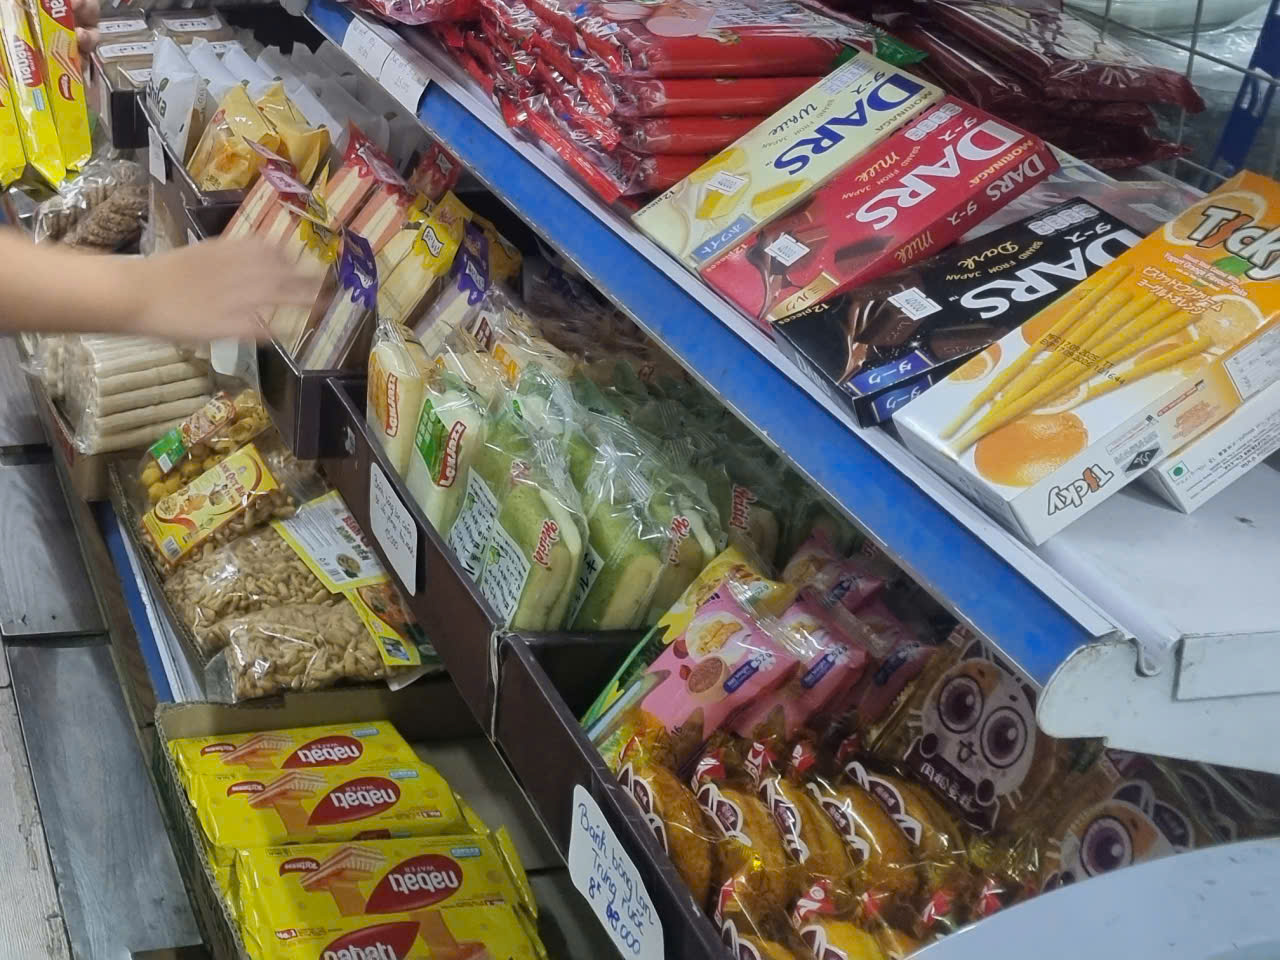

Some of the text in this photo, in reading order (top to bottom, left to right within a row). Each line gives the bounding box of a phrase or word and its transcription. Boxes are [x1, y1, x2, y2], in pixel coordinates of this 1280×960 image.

[851, 71, 887, 94] ダース
[768, 104, 818, 137] White
[774, 73, 926, 176] DARS
[875, 90, 933, 133] MORINAGA
[937, 116, 978, 141] ダース
[854, 119, 1025, 231] DARS
[855, 151, 901, 183] Milk
[876, 168, 900, 185] FROM
[970, 140, 1034, 186] MORINAGA
[985, 152, 1047, 202] DARS
[841, 184, 872, 200] JAPAN
[947, 200, 978, 227] ダース
[699, 220, 744, 256] ホワイト
[1064, 221, 1112, 243] ダース
[706, 242, 749, 273] 12pieces
[894, 230, 934, 265] Milk
[945, 240, 1044, 282] BRAND FROM JAPAN
[957, 240, 1020, 269] Dark
[960, 228, 1144, 320] DARS
[784, 286, 822, 311] ミルク
[778, 302, 831, 325] 12pieces
[869, 359, 912, 383] ダーク
[1047, 463, 1115, 516] Ticky
[297, 744, 361, 766] nabati
[330, 787, 397, 809] nabati
[388, 869, 459, 895] nabati
[403, 863, 436, 873] WAFER
